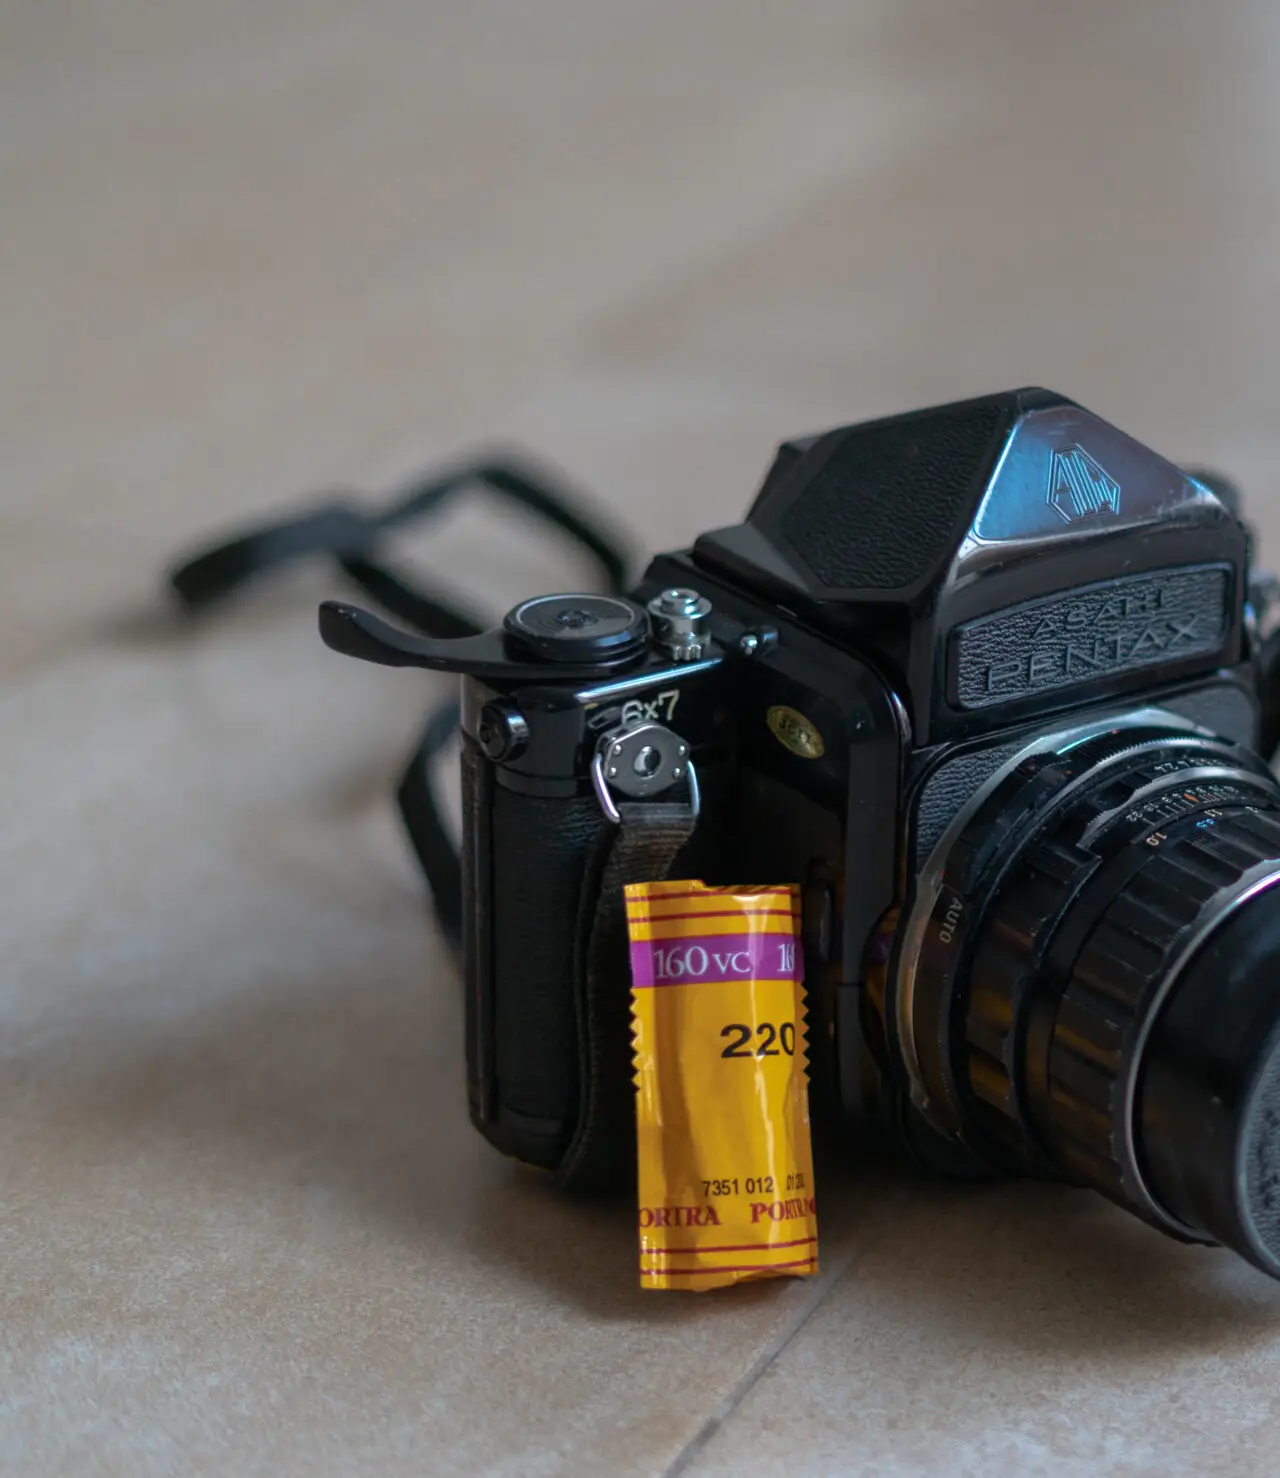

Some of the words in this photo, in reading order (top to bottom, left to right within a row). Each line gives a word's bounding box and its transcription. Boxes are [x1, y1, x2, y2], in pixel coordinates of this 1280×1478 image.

[1031, 587, 1163, 641] ASAHI
[986, 614, 1200, 692] PENTAX
[621, 689, 680, 725] 6x7
[1126, 810, 1143, 822] 22
[1145, 832, 1167, 847] 1.0
[938, 897, 965, 944] AUTO
[653, 945, 708, 979] 160
[719, 1022, 796, 1059] 220
[701, 1178, 740, 1197] 7351
[745, 1176, 775, 1194] 012
